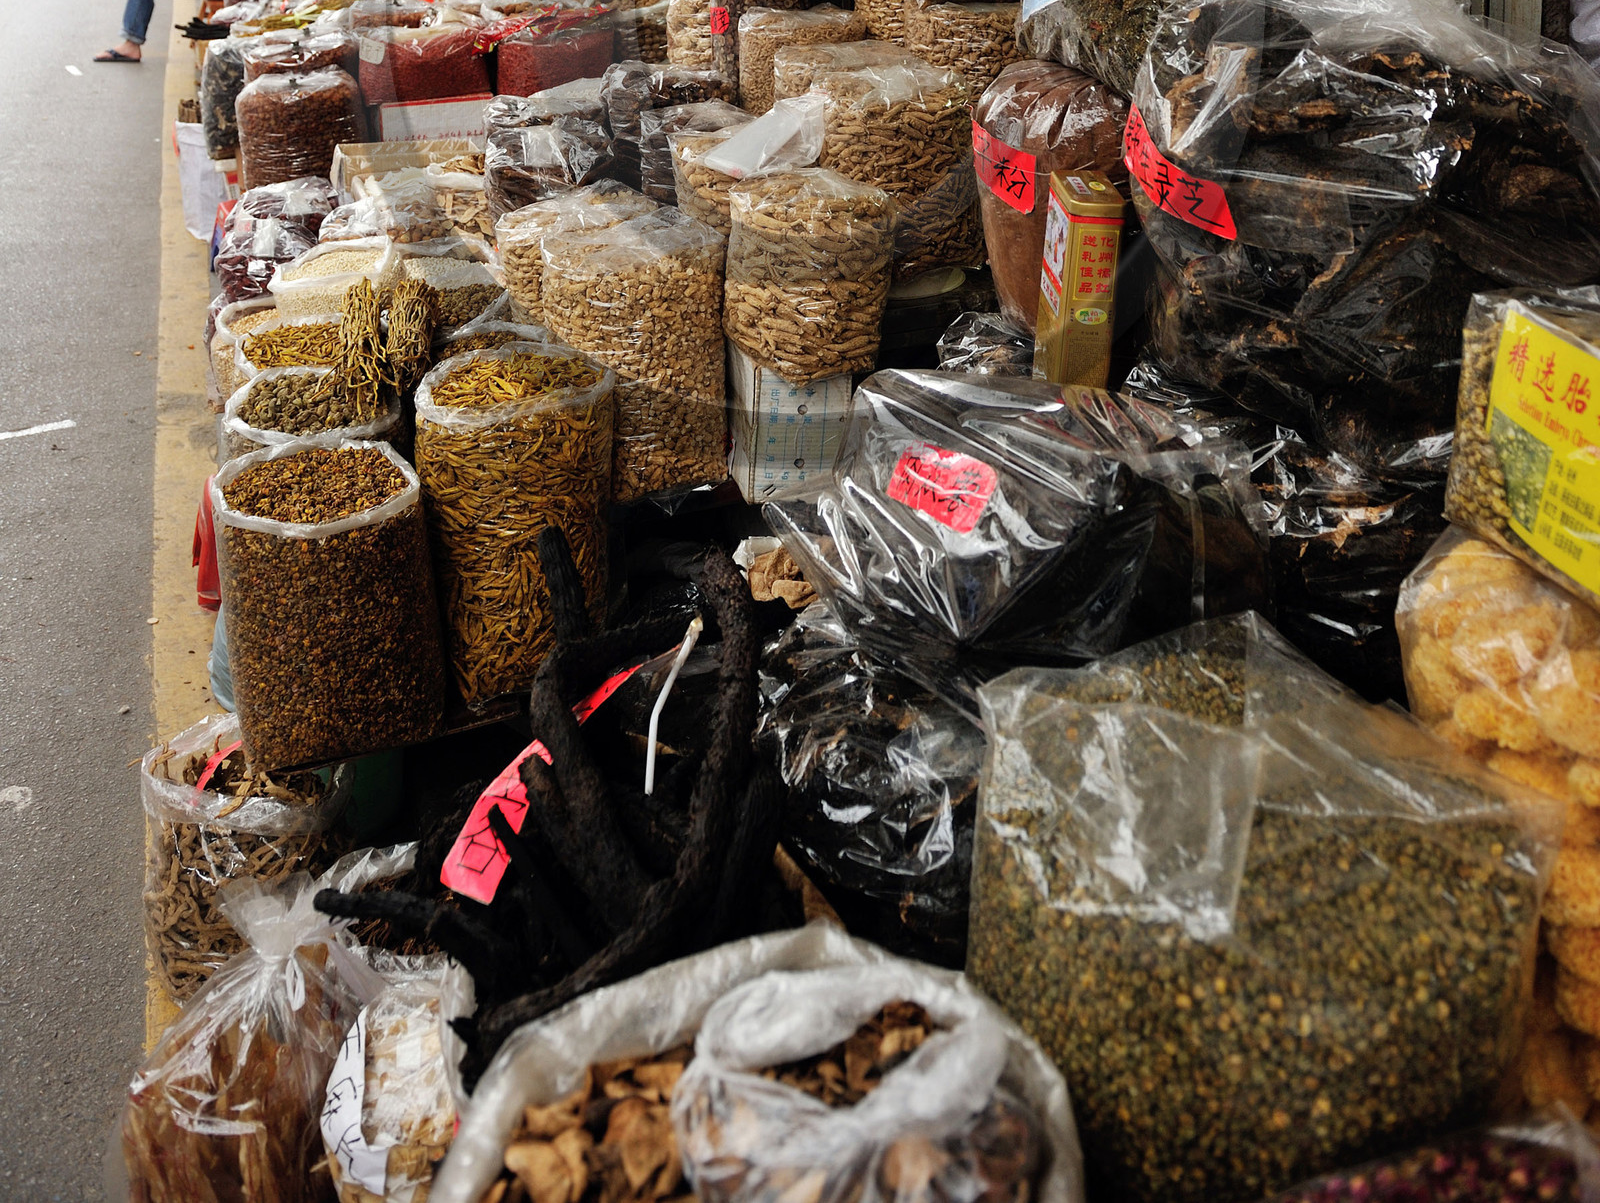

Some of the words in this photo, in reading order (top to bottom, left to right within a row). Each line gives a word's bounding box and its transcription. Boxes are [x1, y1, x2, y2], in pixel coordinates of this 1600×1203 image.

[1078, 235, 1097, 294] 送礼佳品
[1095, 236, 1115, 294] 化州橘红
[1508, 336, 1599, 416] 精选胎
